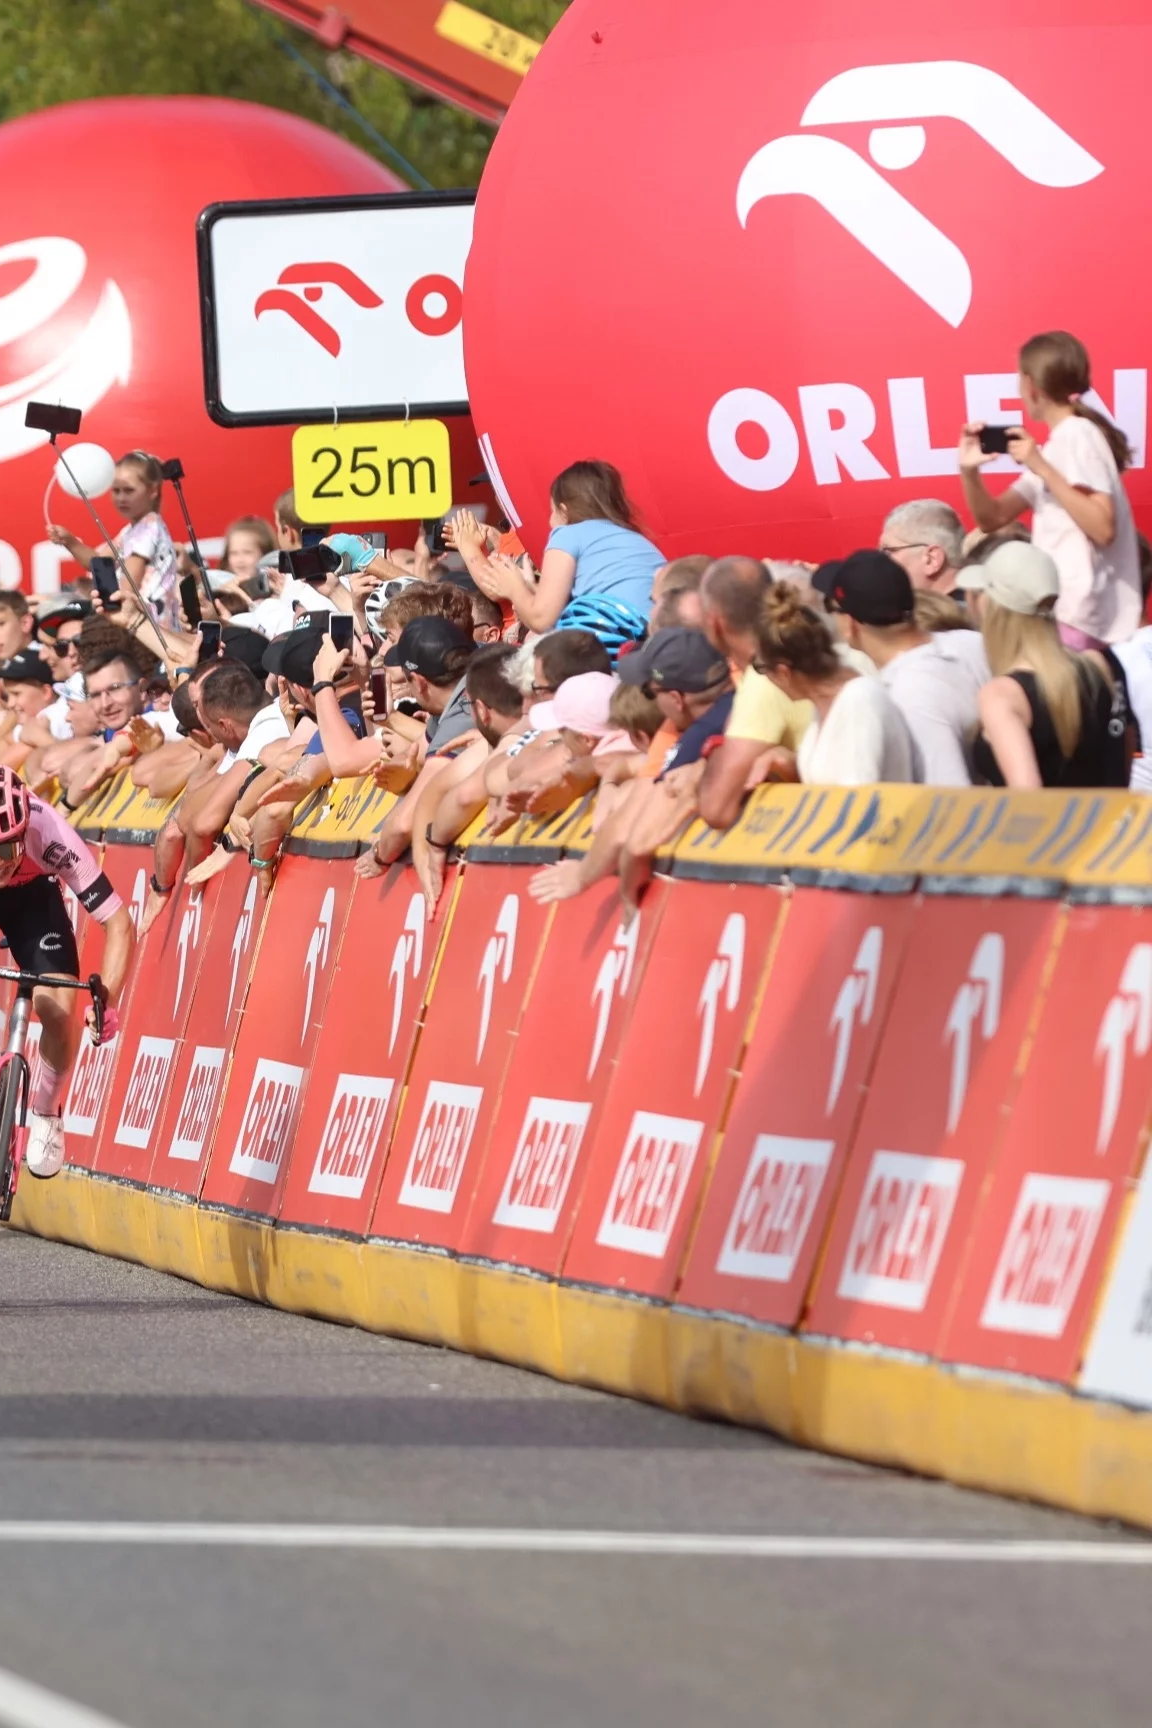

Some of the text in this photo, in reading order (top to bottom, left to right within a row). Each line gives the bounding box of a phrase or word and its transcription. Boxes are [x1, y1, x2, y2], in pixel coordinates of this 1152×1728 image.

[312, 446, 436, 498] 25m
[122, 1053, 170, 1131] ORLEN
[176, 1062, 222, 1142] ORLEN
[241, 1077, 298, 1165] ORLEN
[320, 1092, 386, 1178] ORLEN
[411, 1101, 475, 1192] ORLEN
[508, 1117, 585, 1211] ORLEN
[610, 1133, 695, 1233] ORLEN
